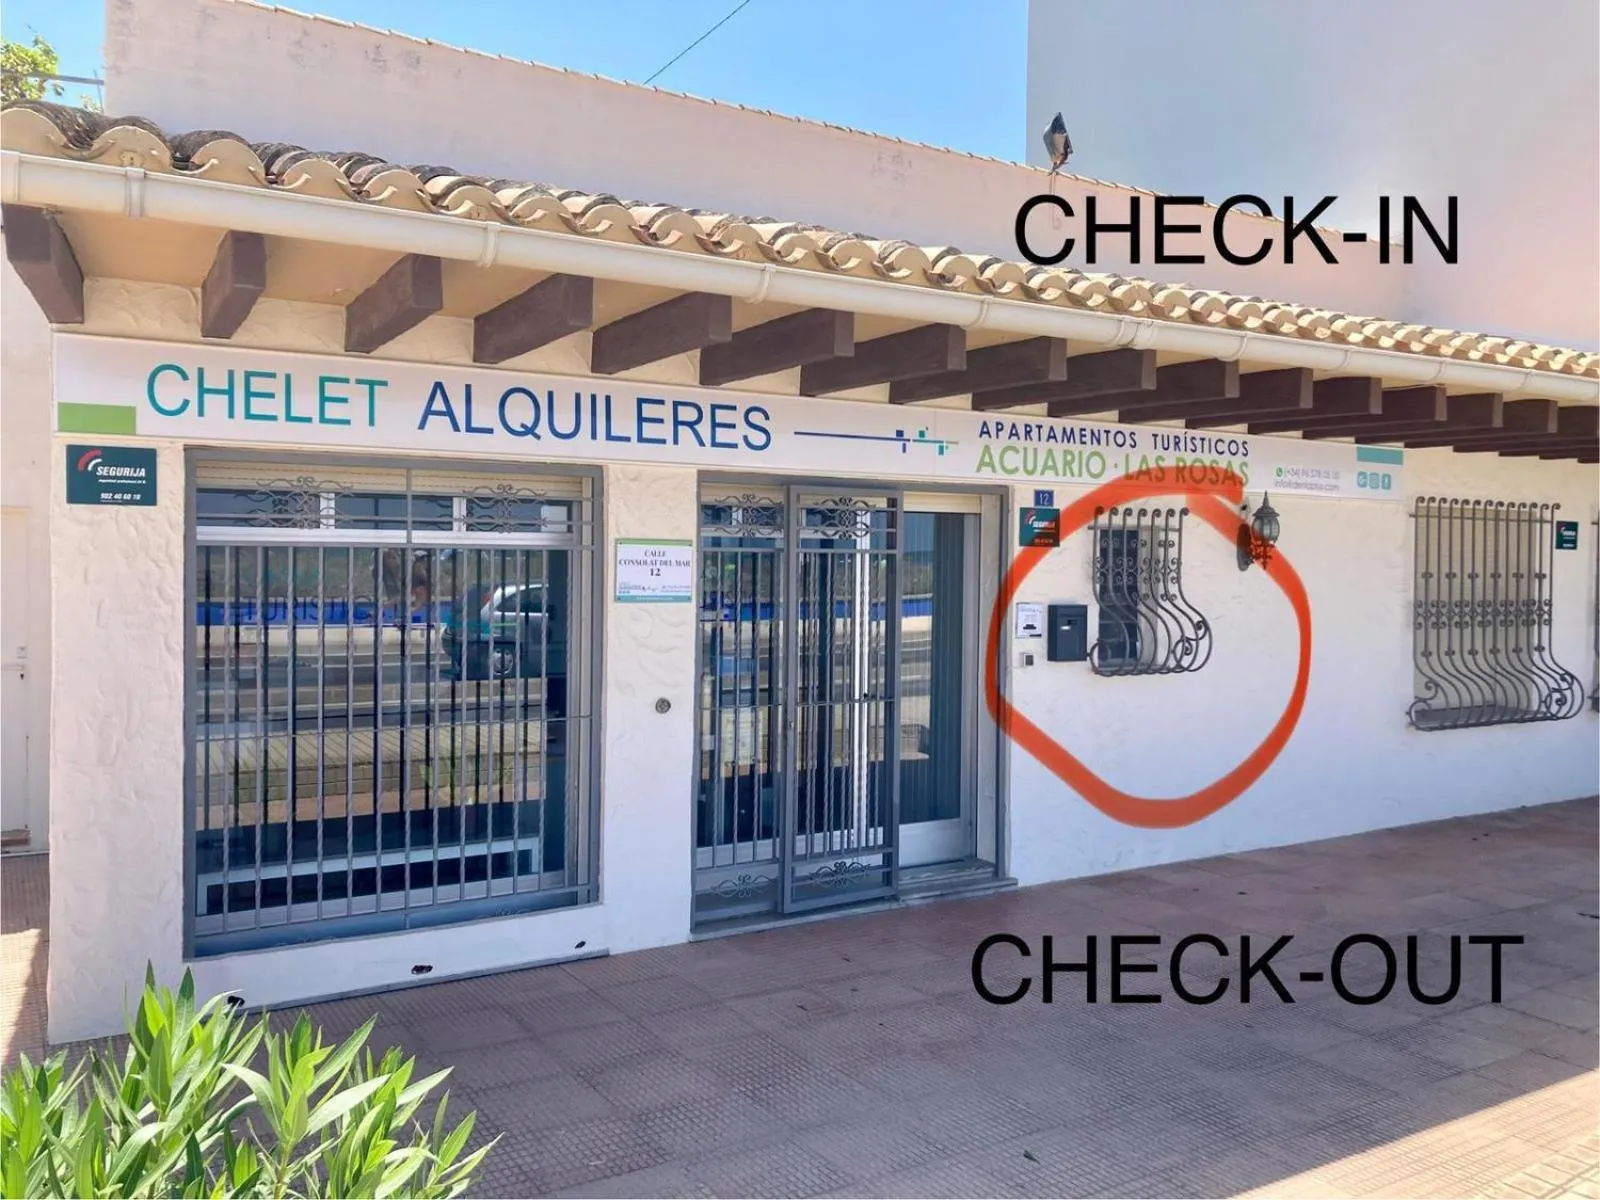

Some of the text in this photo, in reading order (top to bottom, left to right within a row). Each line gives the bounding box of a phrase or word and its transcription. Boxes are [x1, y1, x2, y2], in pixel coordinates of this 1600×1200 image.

[147, 363, 771, 451] CHELET ALQUILERES
[979, 420, 1249, 457] APARTAMENTOS TURÍSTICOS
[976, 444, 1106, 479] ACUARIO
[1124, 453, 1166, 483] LAS
[1175, 457, 1249, 486] ROSAS
[96, 466, 146, 477] SEGURIJA
[1039, 493, 1050, 505] 12
[619, 559, 658, 567] CONSOLAT
[659, 559, 672, 567] DEL
[650, 568, 661, 577] 12
